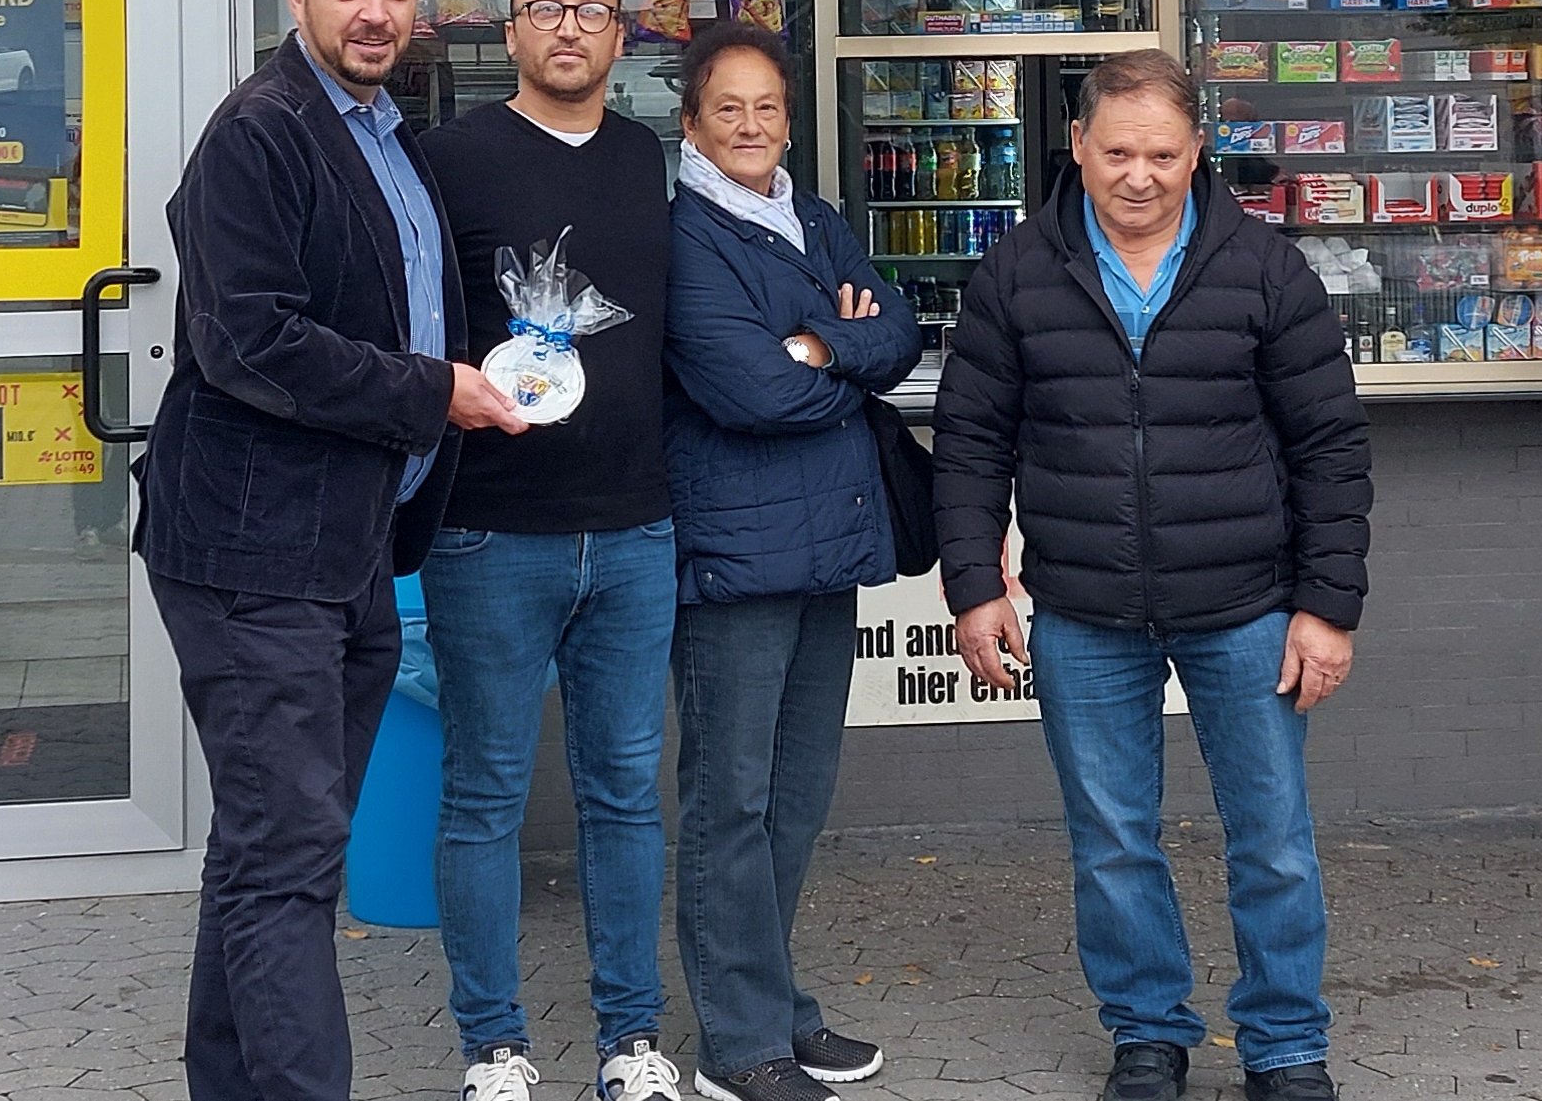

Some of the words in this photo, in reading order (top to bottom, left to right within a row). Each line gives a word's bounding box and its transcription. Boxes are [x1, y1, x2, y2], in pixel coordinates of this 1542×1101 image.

[11, 145, 19, 159] €
[1465, 202, 1498, 215] duplo
[55, 450, 95, 462] LOTTO
[897, 666, 959, 705] hier
